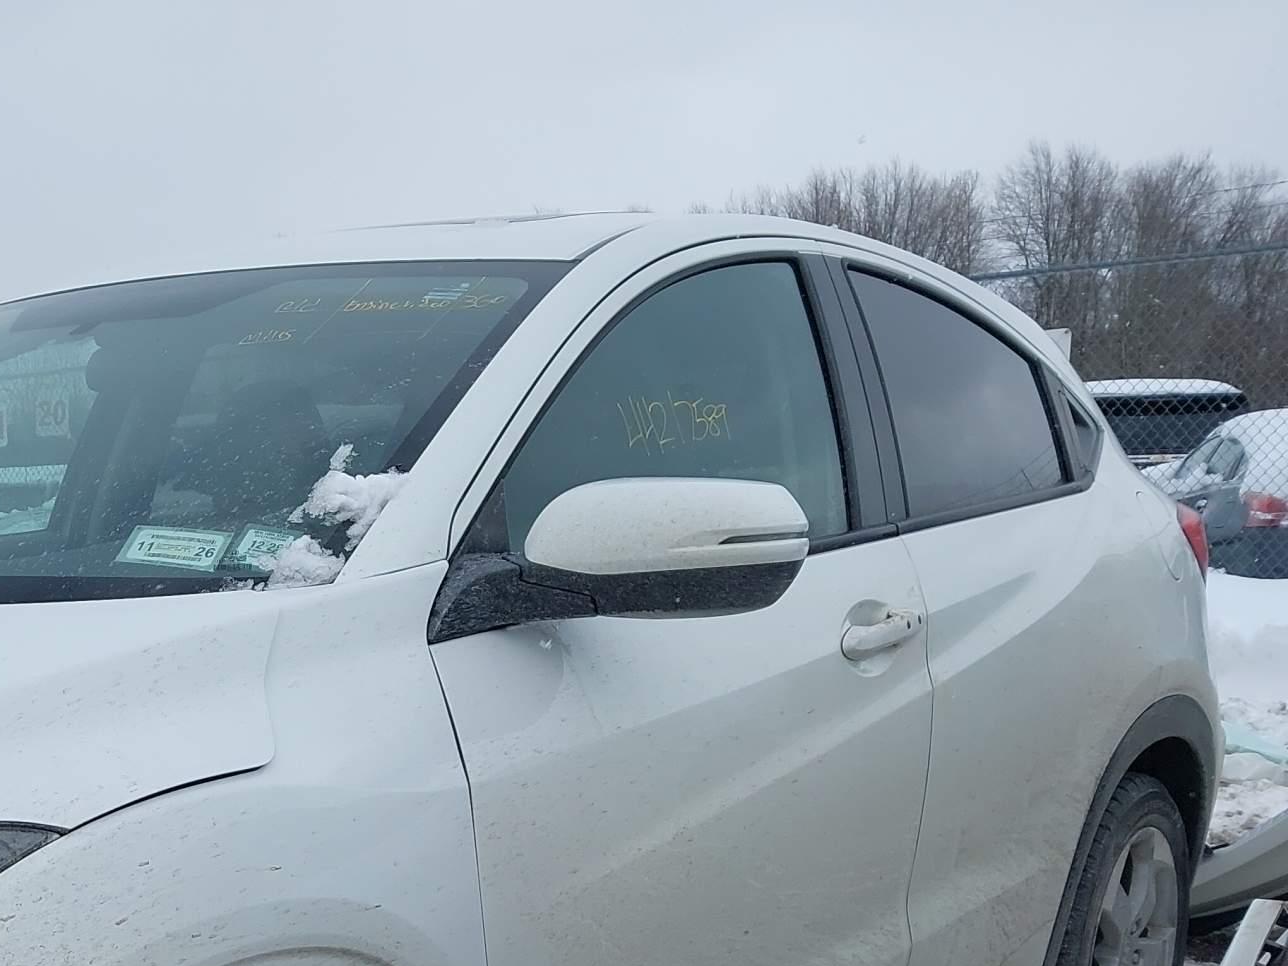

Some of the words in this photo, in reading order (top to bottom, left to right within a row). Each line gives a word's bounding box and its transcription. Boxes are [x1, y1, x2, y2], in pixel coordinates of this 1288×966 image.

[37, 399, 67, 426] 20
[136, 540, 155, 552] 11
[193, 546, 216, 559] 26
